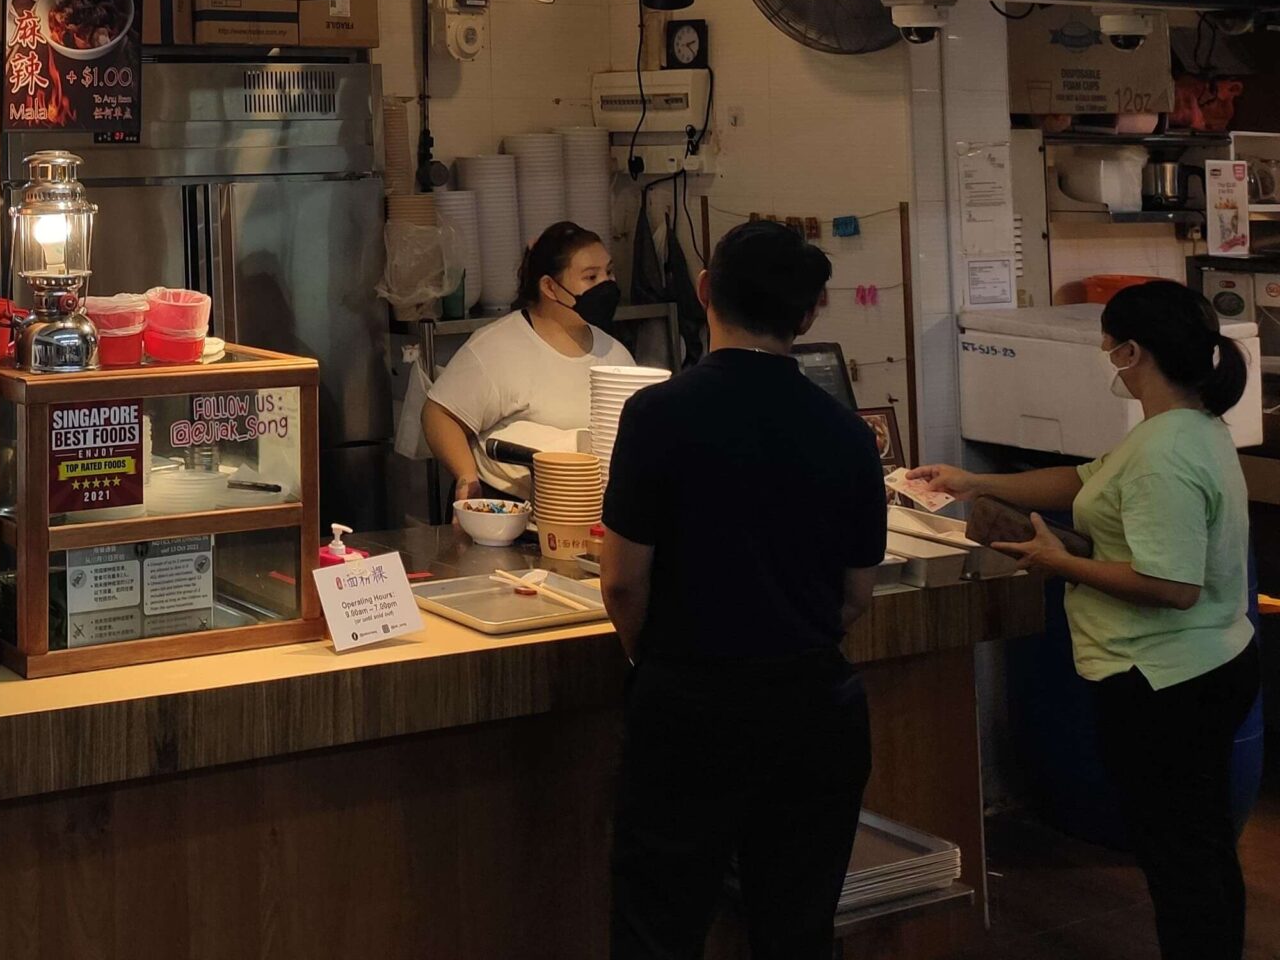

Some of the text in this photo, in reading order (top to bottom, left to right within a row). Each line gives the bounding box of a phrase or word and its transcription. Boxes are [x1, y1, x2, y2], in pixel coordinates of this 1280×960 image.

[326, 21, 353, 30] FRAGILE
[81, 66, 132, 87] $1.00
[9, 97, 48, 120] Mala
[93, 94, 117, 107] To Any
[193, 395, 248, 420] FOLLOW
[52, 405, 138, 429] SINGAPORE
[54, 425, 136, 449] BEST FOODS
[66, 458, 126, 473] TOP RATED FOODS
[84, 490, 111, 503] 2021
[342, 596, 373, 609] Operating
